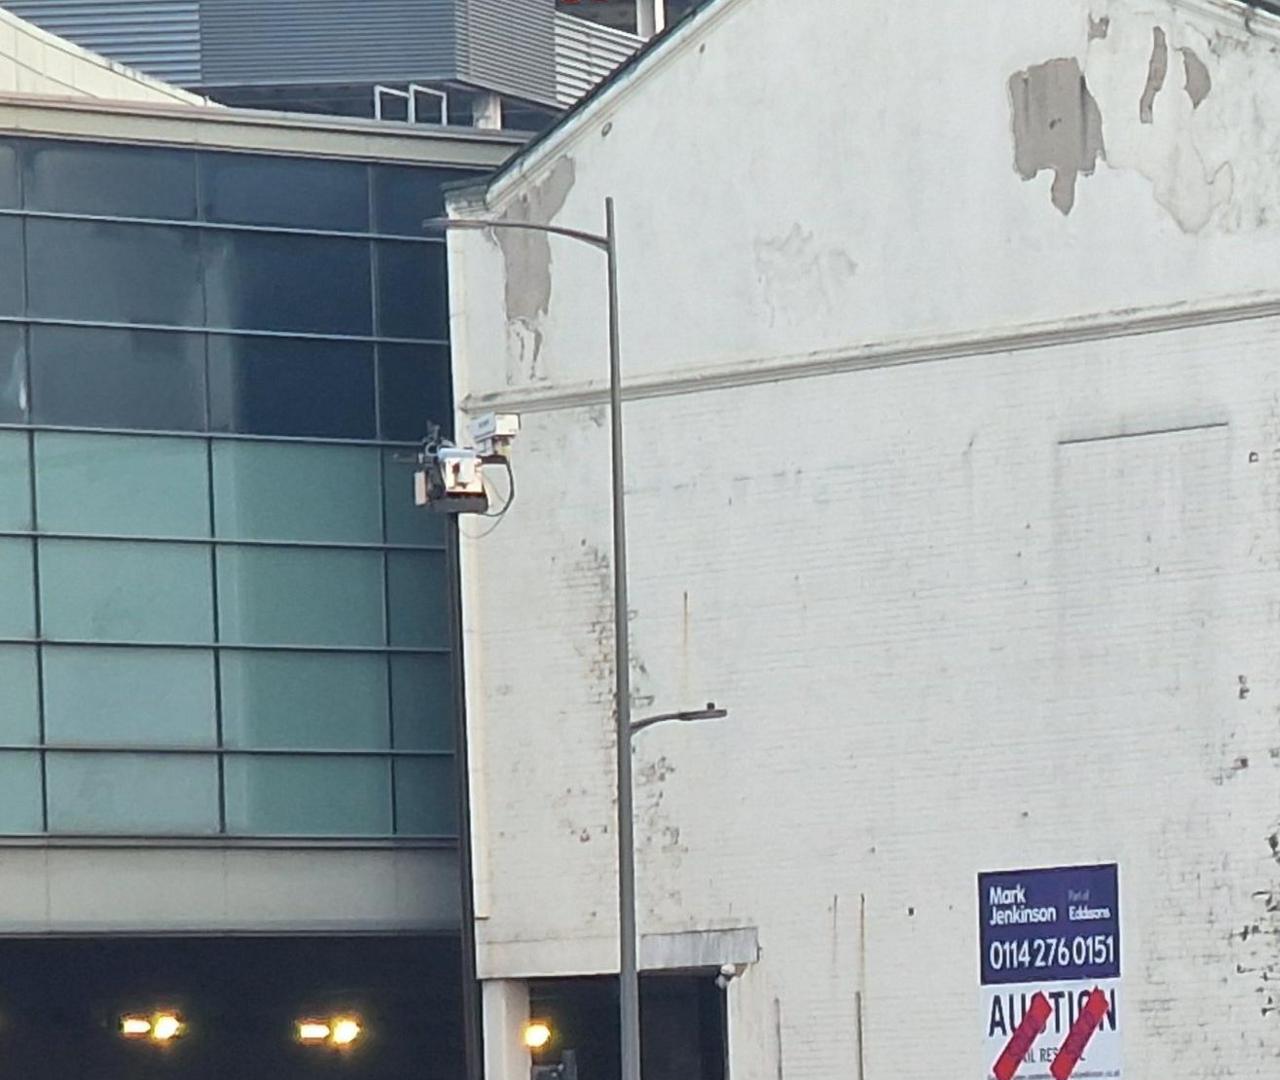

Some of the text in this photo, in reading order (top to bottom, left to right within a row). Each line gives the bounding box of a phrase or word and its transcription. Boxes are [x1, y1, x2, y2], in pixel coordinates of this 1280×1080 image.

[989, 884, 1026, 905] Mark
[989, 905, 1057, 926] Jenkinson
[990, 935, 1114, 970] 0114 276 0151
[989, 987, 1117, 1037] AUTIN
